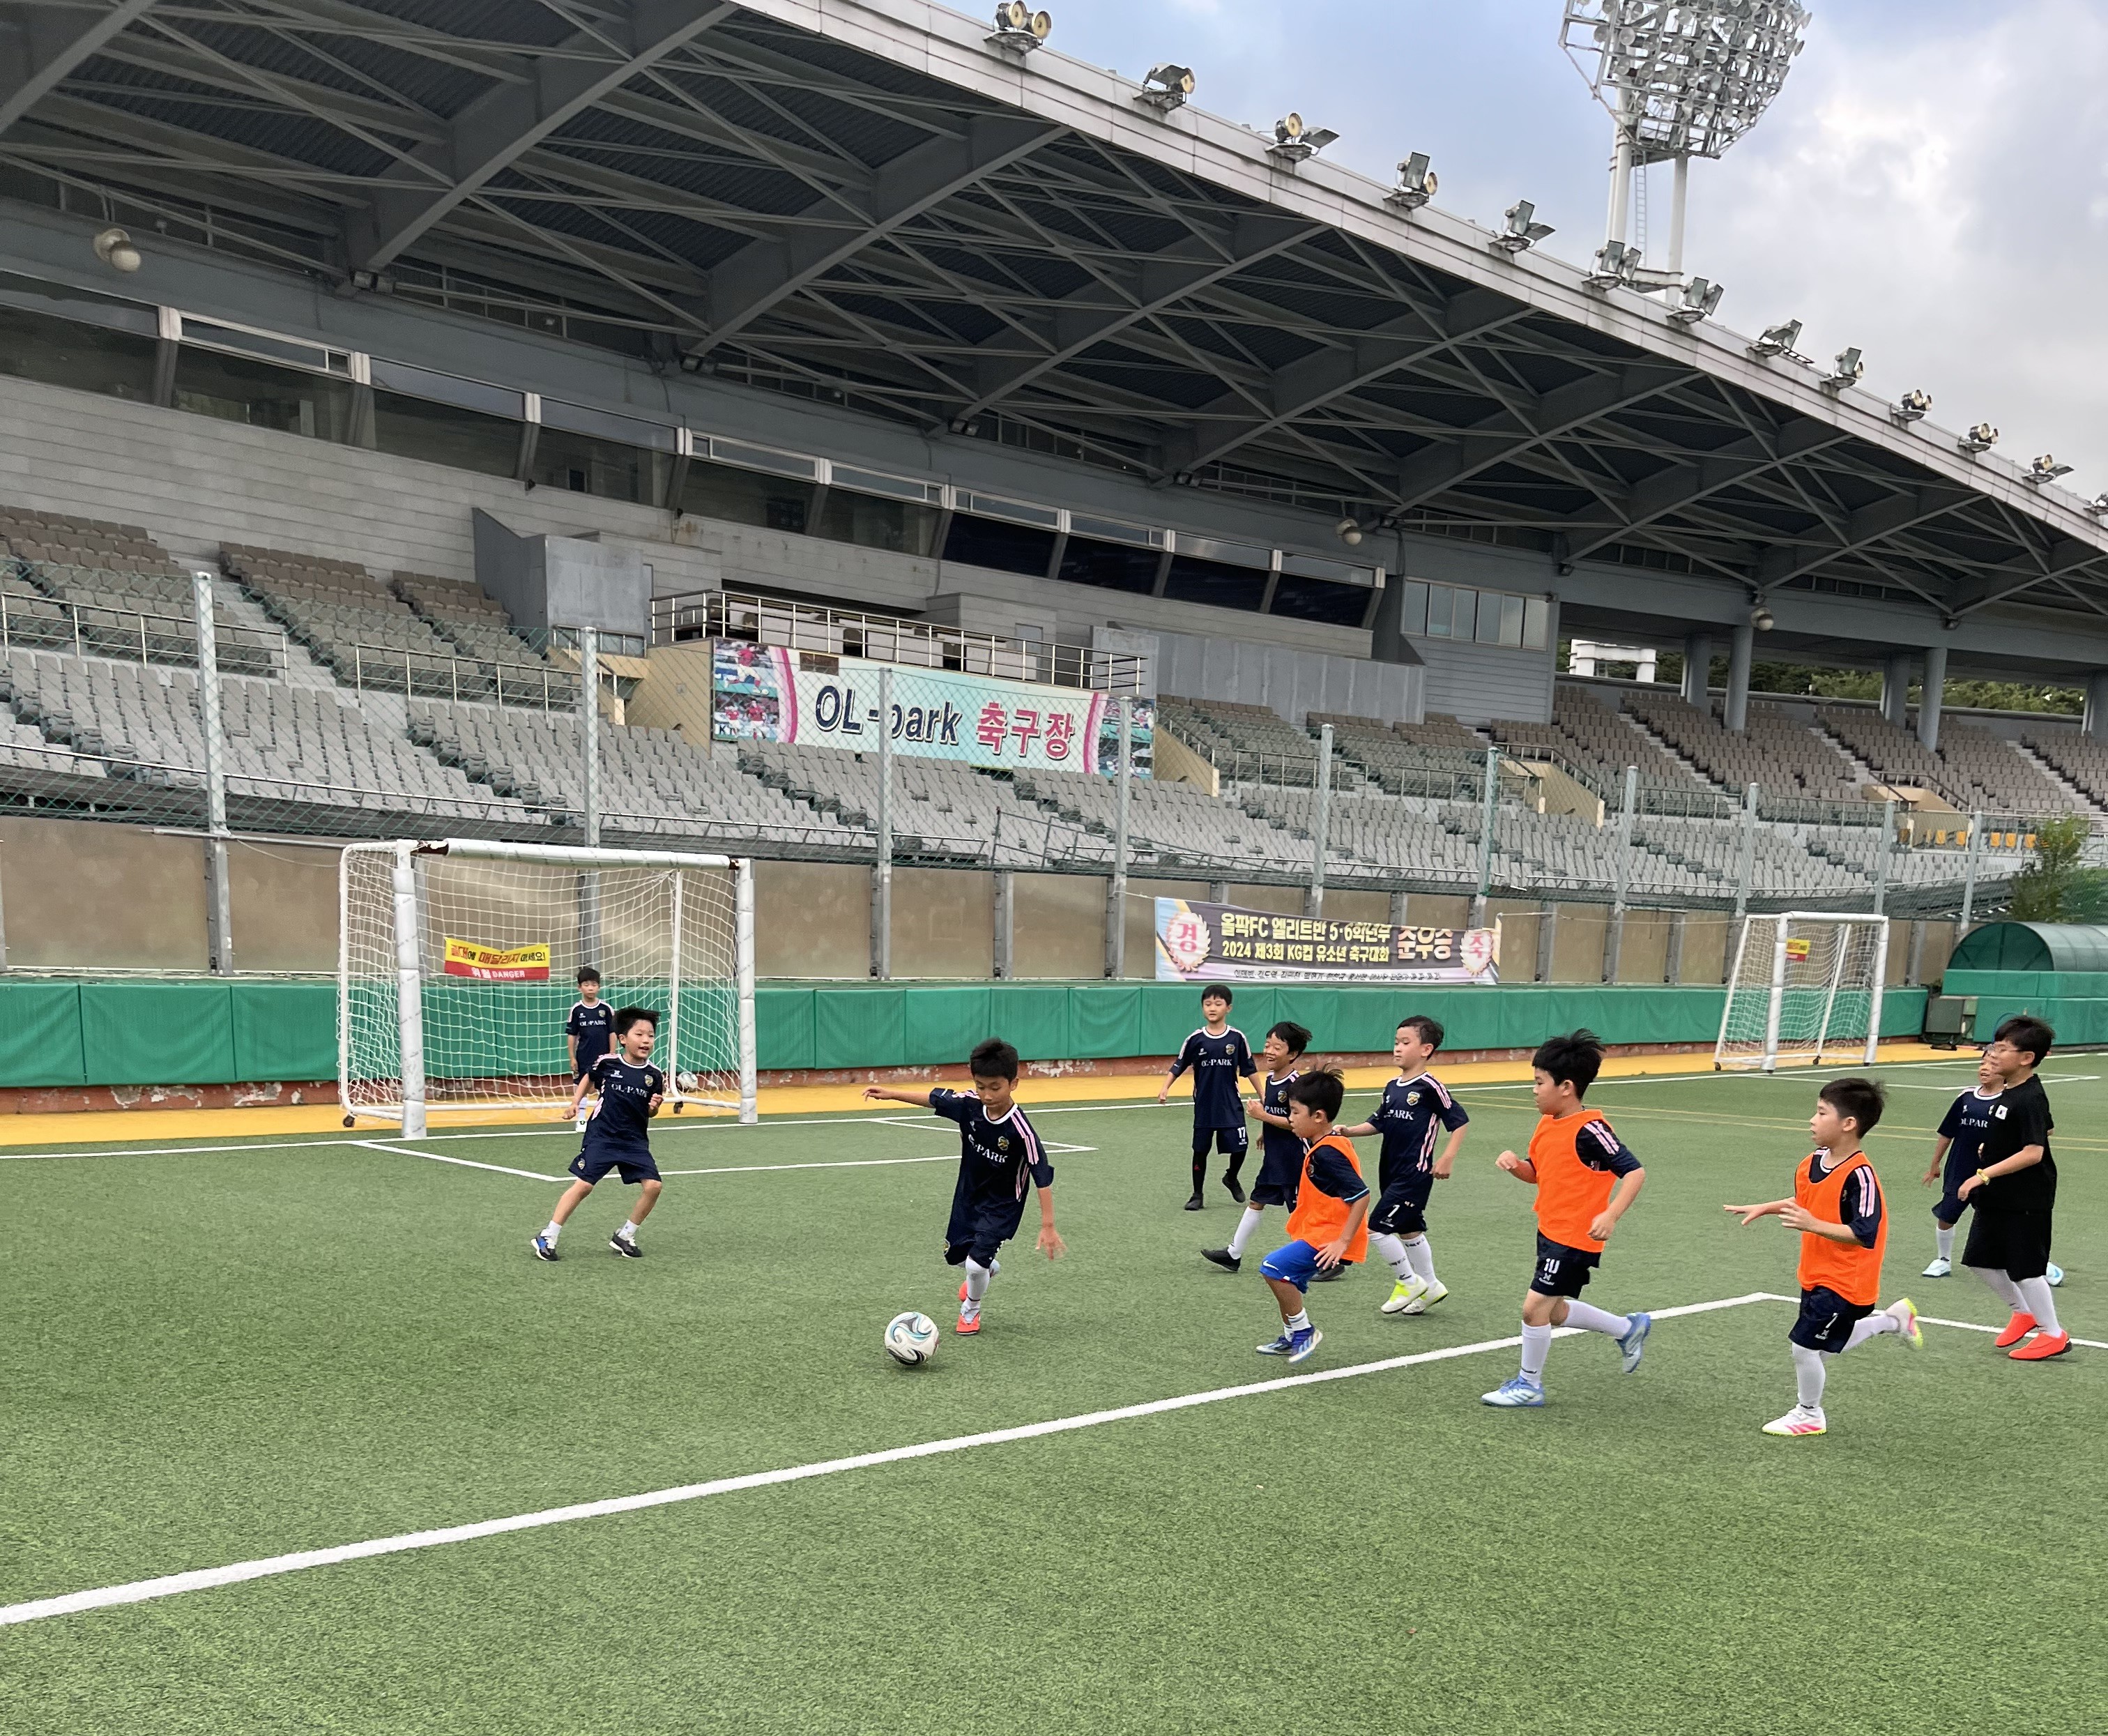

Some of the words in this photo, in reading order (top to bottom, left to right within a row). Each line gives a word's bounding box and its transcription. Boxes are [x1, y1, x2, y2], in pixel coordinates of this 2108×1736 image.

[977, 702, 1075, 760] 축구장
[1177, 923, 1197, 952] 경
[1221, 913, 1269, 938] 올팍FC
[1271, 917, 1327, 941] 엘리트반
[1222, 941, 1251, 958] 2024
[1254, 943, 1284, 960] 제3회
[1287, 944, 1313, 961] KG컵
[1316, 945, 1347, 962] 유소년
[1349, 945, 1389, 963] 축구대회
[1397, 925, 1453, 960] 준우승
[492, 970, 525, 978] DANGER
[1237, 1127, 1246, 1139] 17
